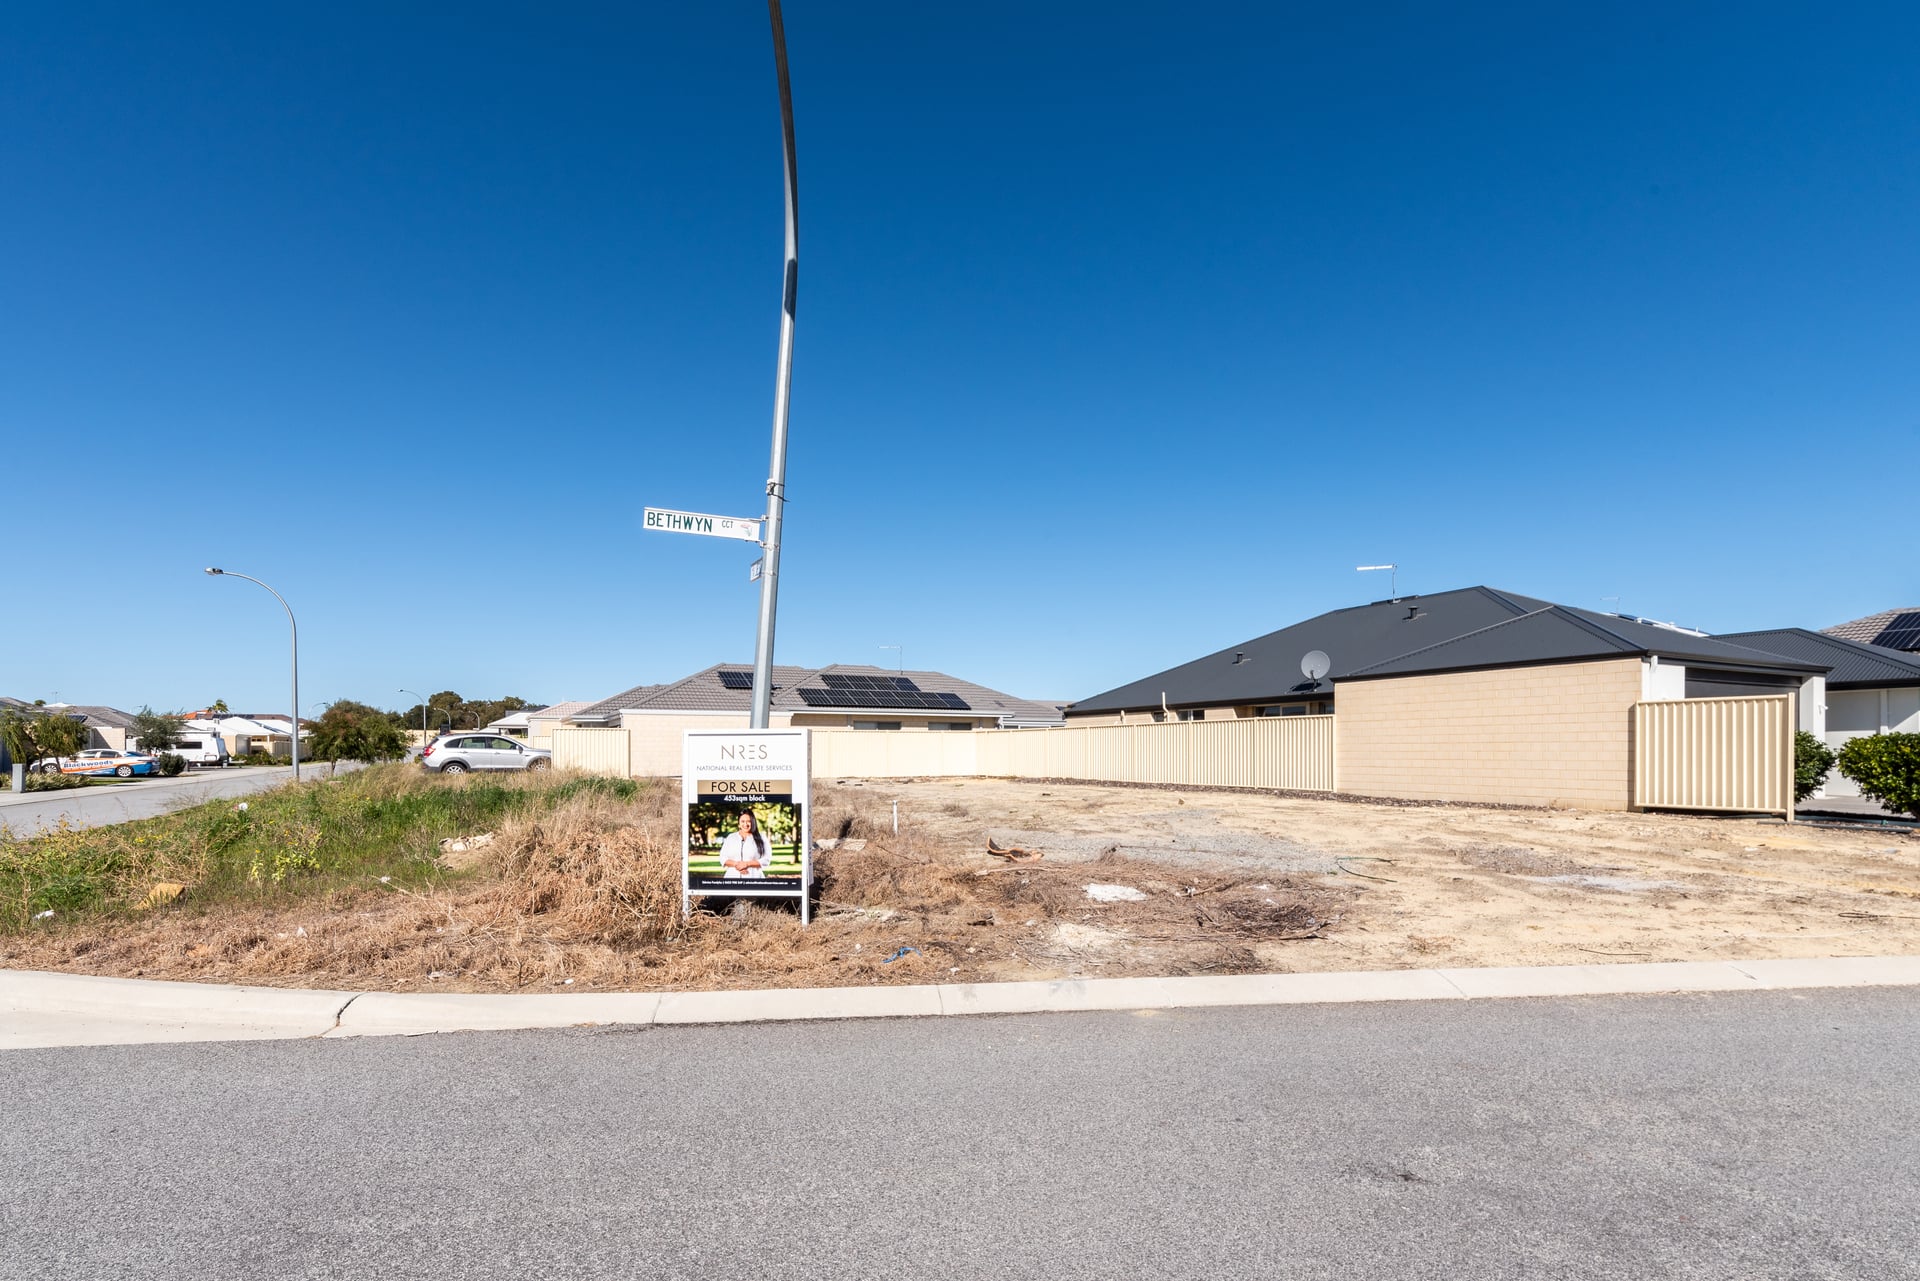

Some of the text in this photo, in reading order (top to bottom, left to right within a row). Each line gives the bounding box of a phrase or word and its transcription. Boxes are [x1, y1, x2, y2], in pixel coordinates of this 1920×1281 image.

[647, 512, 734, 533] BETHWYN CCT
[721, 744, 768, 760] NRES
[63, 760, 113, 768] Blackwoods
[711, 781, 771, 793] FOR SALE
[724, 795, 748, 803] 453sqm
